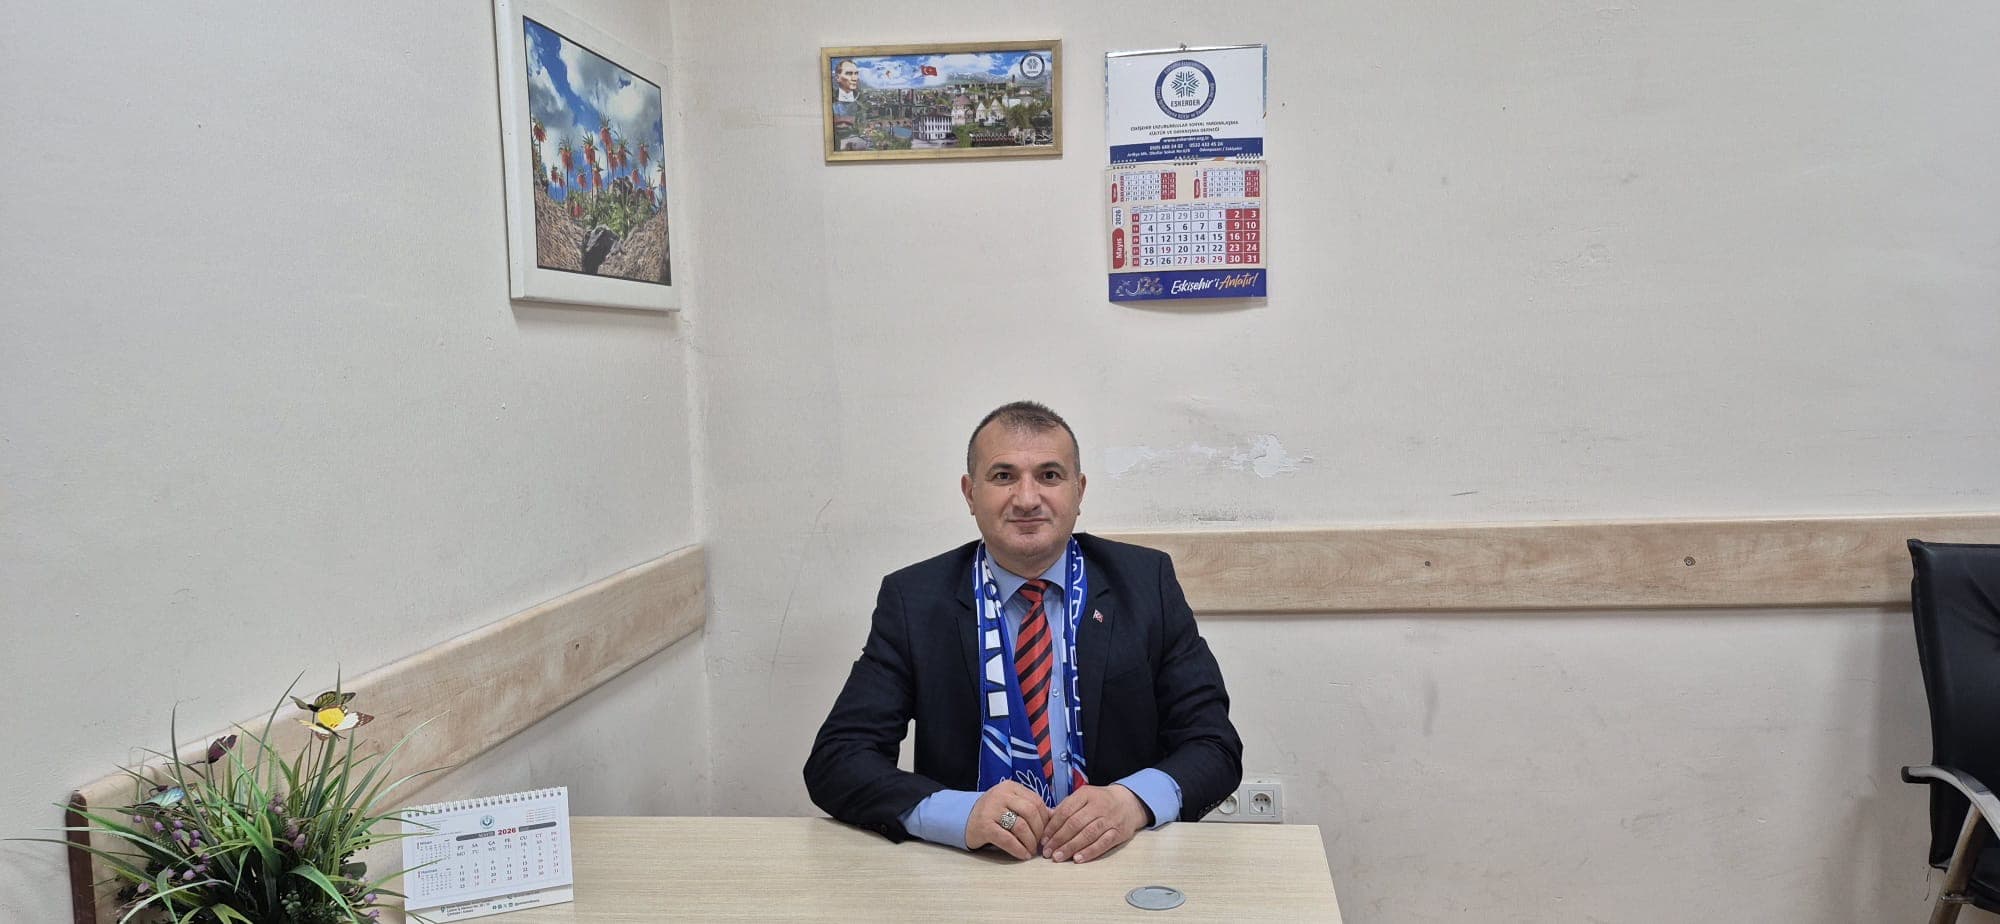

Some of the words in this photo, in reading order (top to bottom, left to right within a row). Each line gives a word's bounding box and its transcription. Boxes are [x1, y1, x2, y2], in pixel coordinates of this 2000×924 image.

[1178, 212, 1188, 220] 29
[1218, 211, 1222, 219] 1
[1234, 210, 1240, 218] 2
[1251, 210, 1257, 218] 3
[1182, 223, 1188, 231] 6
[1218, 222, 1223, 230] 8
[1116, 238, 1124, 259] Mayıs
[1161, 246, 1171, 254] 19
[1178, 245, 1188, 253] 20
[1195, 256, 1206, 264] 28
[1230, 255, 1240, 263] 30
[1247, 255, 1257, 263] 31
[1171, 278, 1218, 294] Eskişehir'i
[1219, 273, 1259, 290] Anlatır!
[498, 827, 517, 835] 2026
